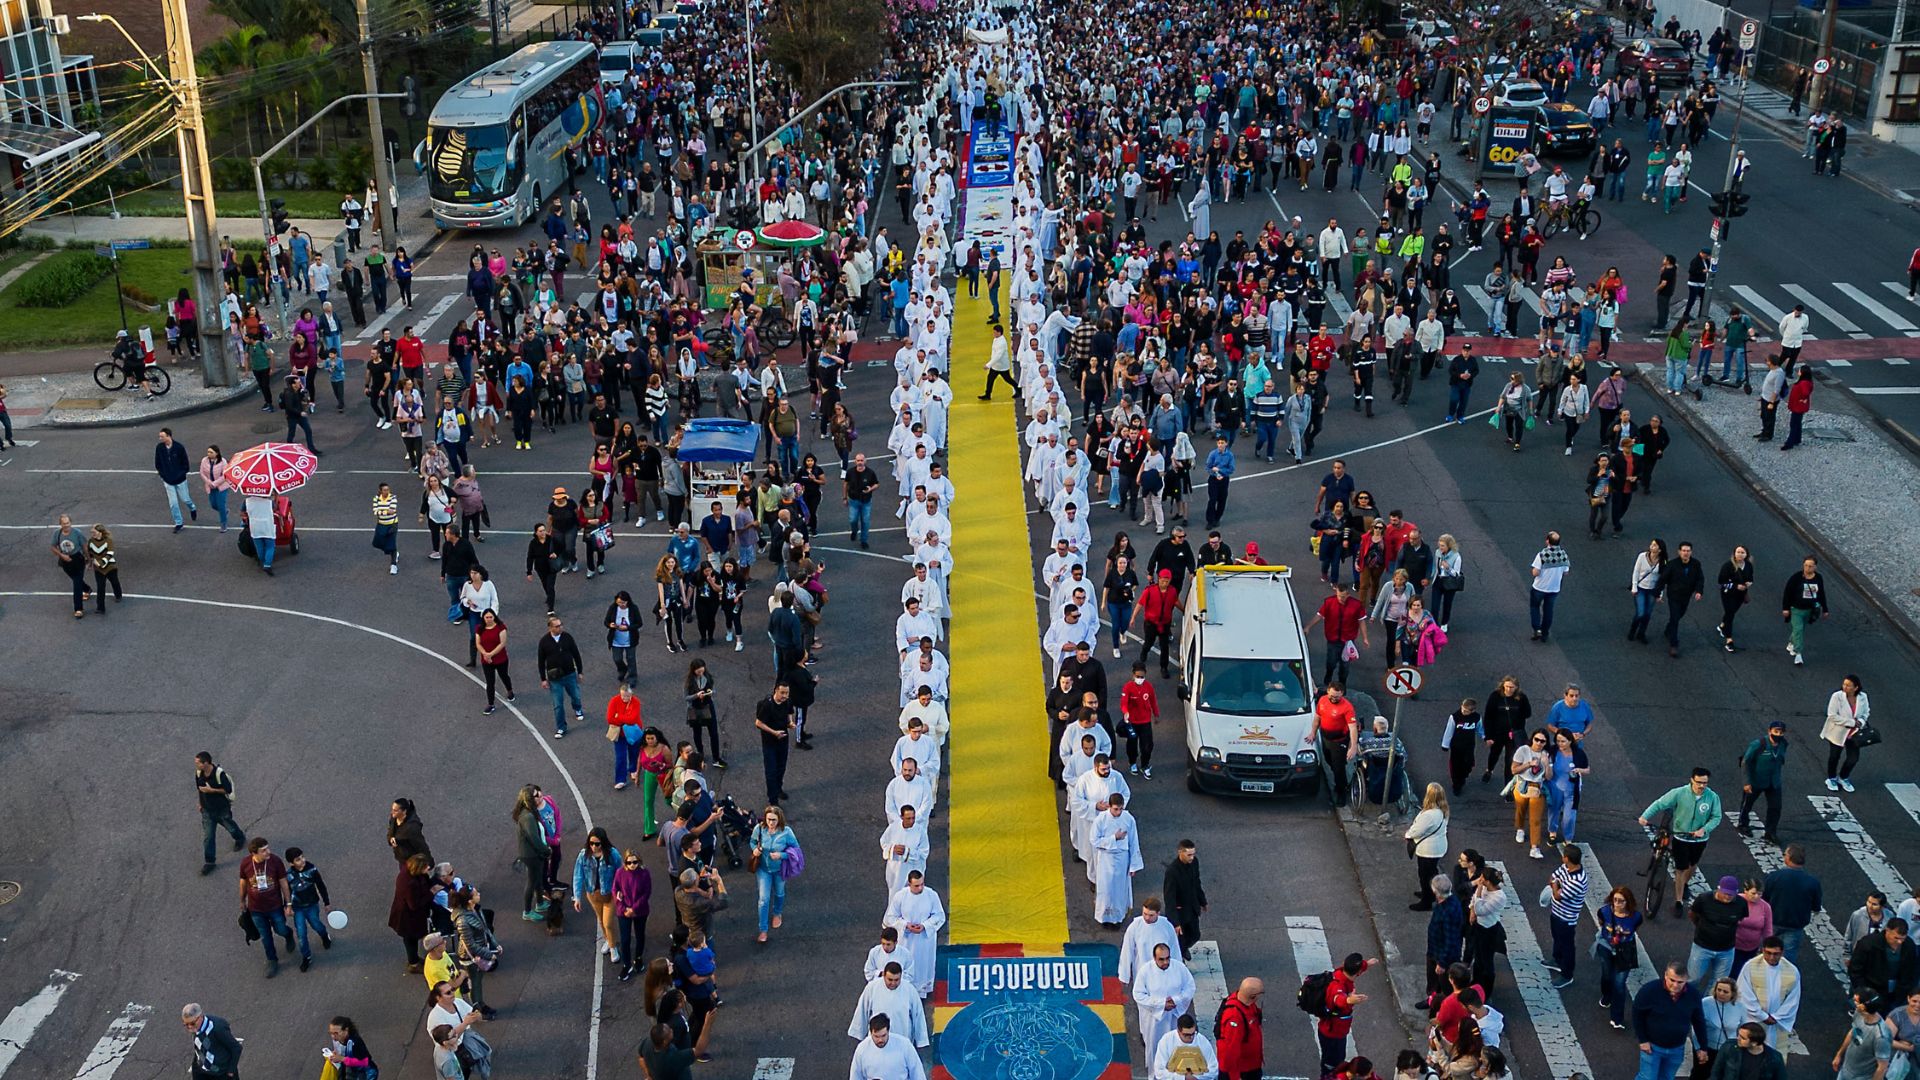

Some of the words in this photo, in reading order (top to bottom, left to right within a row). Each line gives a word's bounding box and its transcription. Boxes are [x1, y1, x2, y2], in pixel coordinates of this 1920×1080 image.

[1746, 25, 1753, 33] E
[1476, 100, 1489, 108] 40
[1496, 128, 1525, 137] DAJU
[281, 480, 301, 490] KIBON
[957, 962, 1089, 995] manancial
